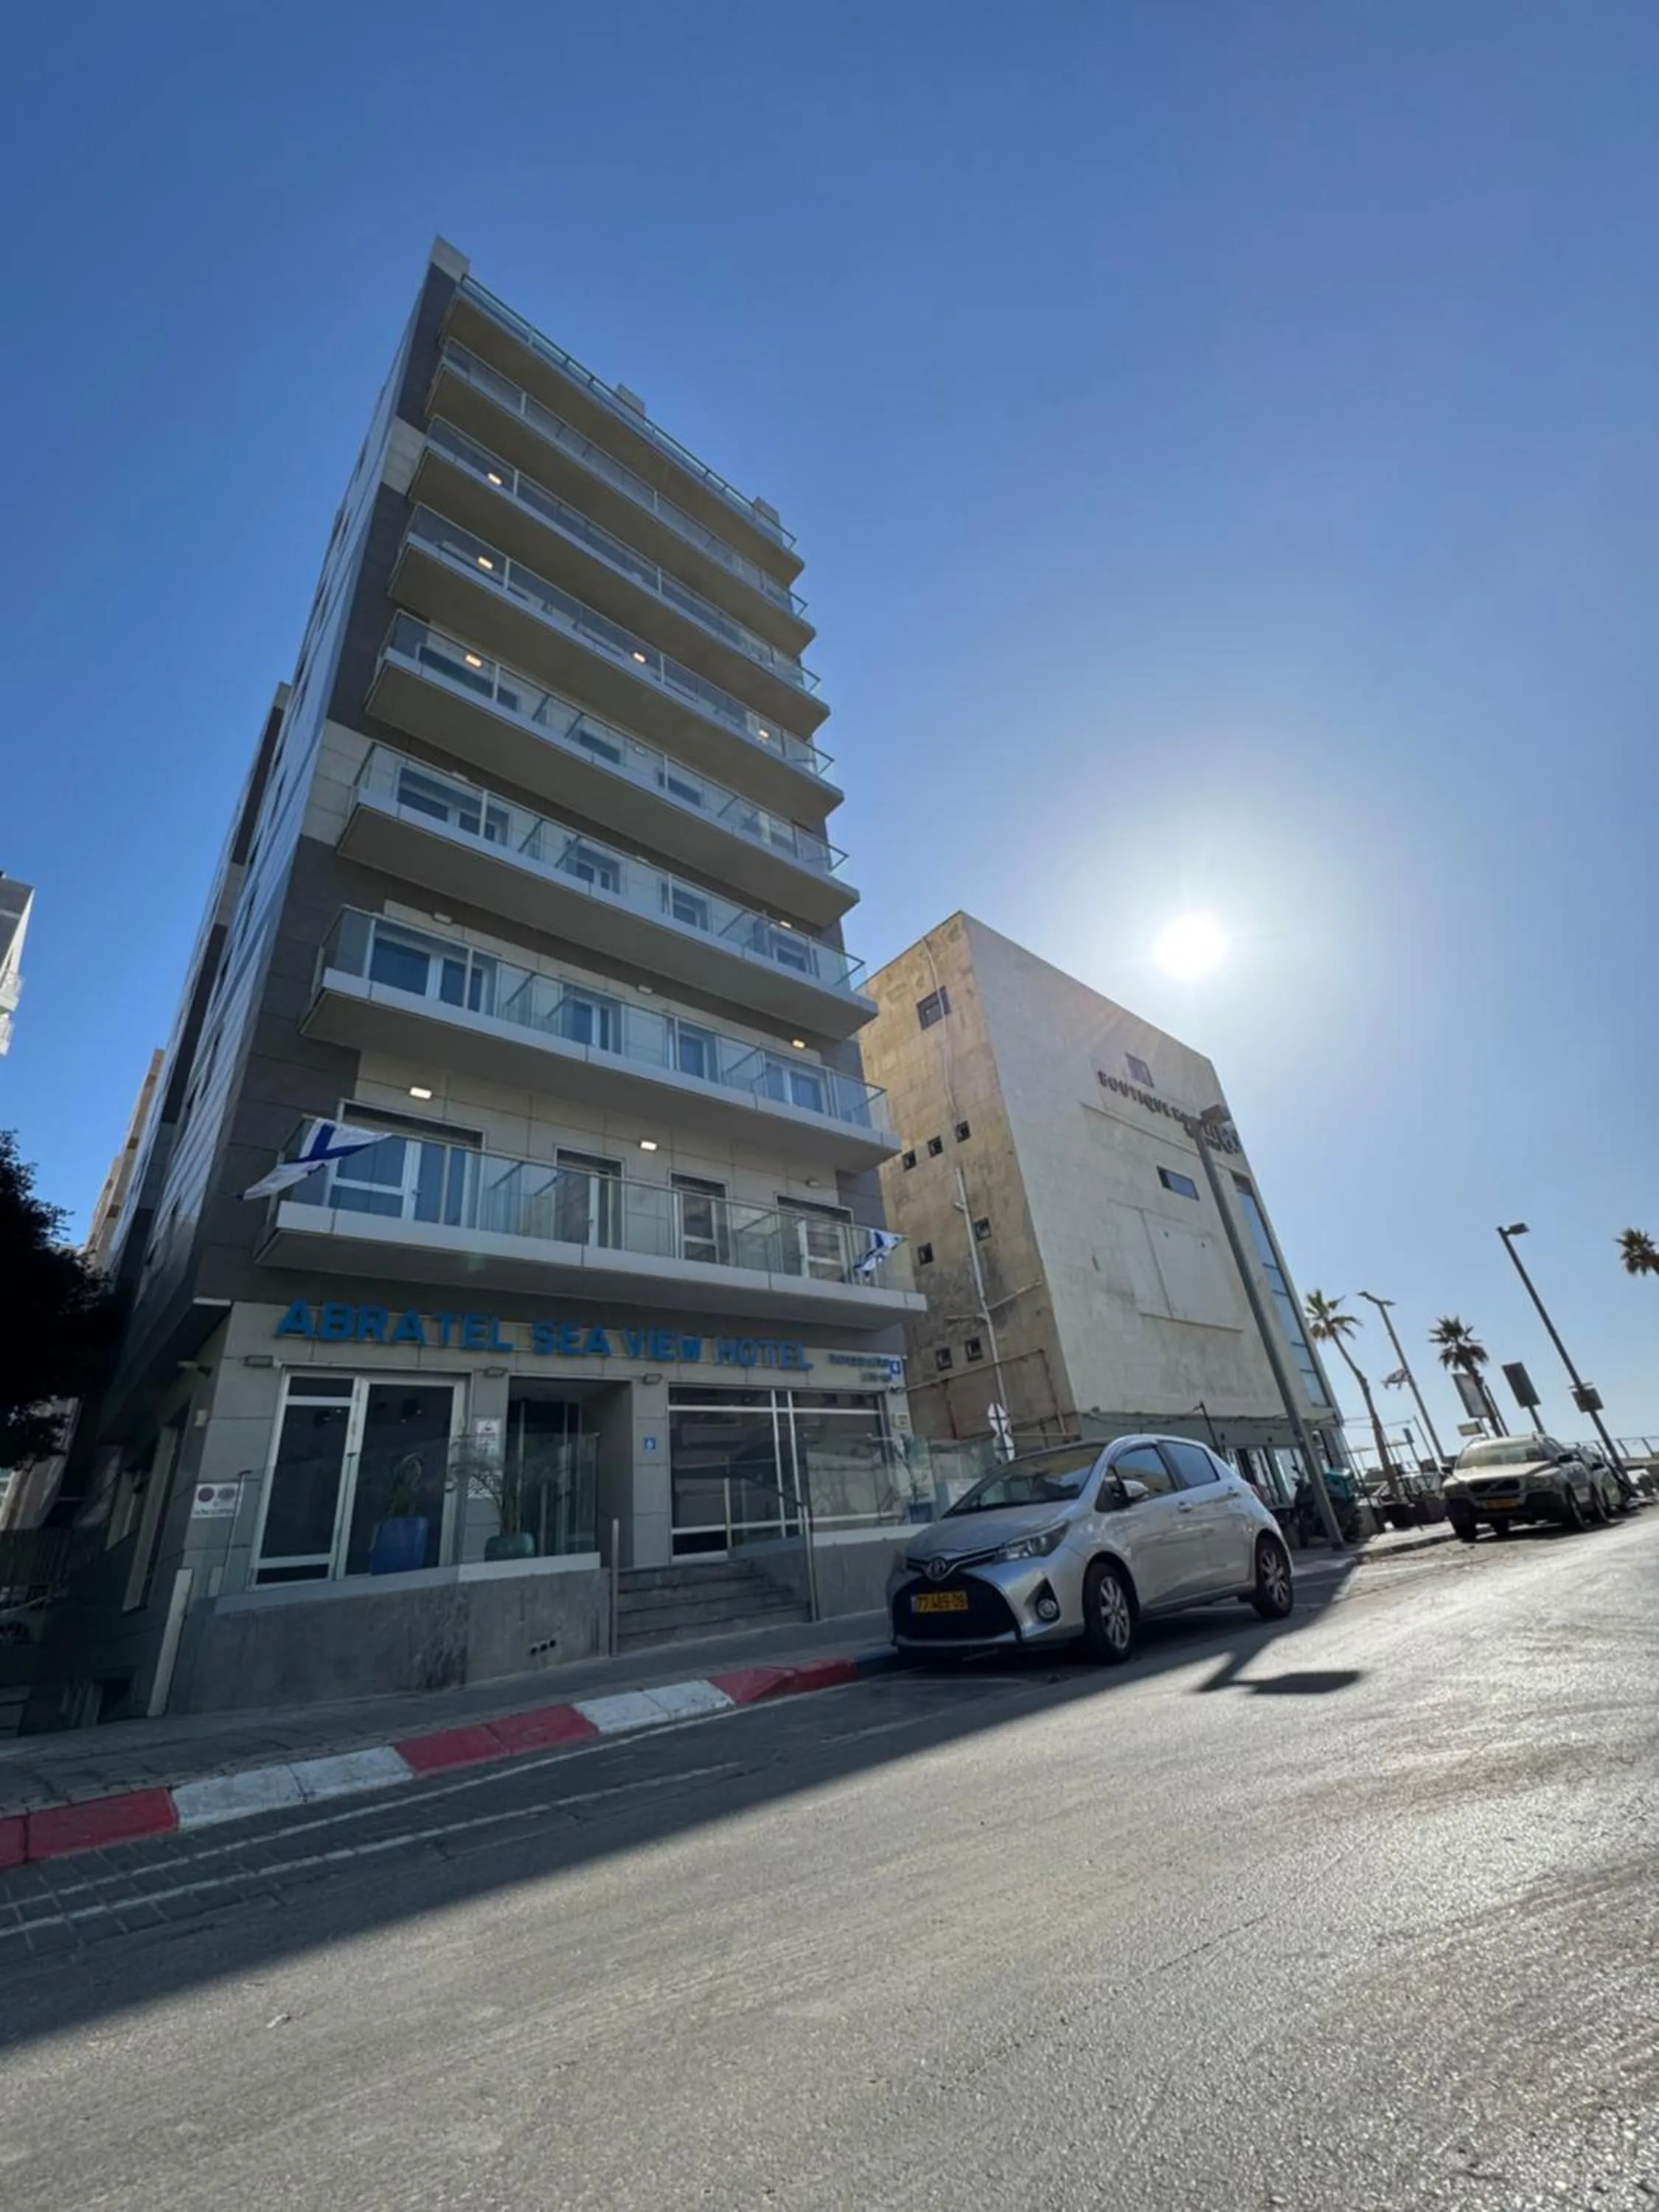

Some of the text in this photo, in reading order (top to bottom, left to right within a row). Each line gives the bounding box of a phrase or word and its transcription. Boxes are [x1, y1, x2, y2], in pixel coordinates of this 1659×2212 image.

[276, 1298, 813, 1370] ABRATEL SEA VIEW HOTEL
